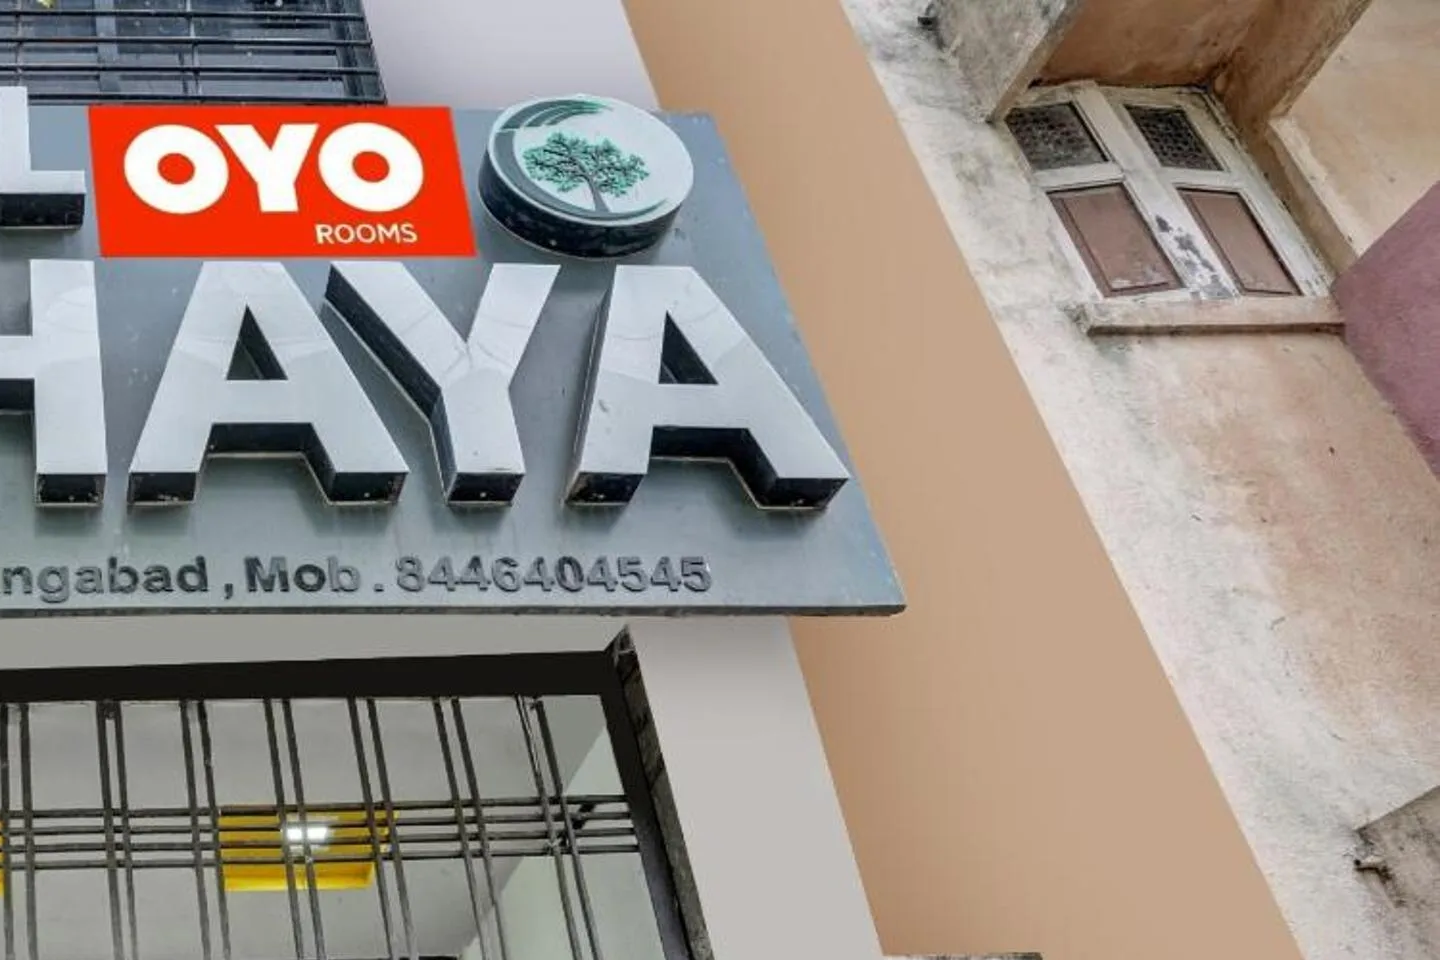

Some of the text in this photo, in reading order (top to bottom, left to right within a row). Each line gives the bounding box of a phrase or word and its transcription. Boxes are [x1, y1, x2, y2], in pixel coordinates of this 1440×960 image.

[123, 122, 425, 215] OYO
[314, 223, 418, 245] ROOMS
[395, 555, 713, 593] 8446404545
